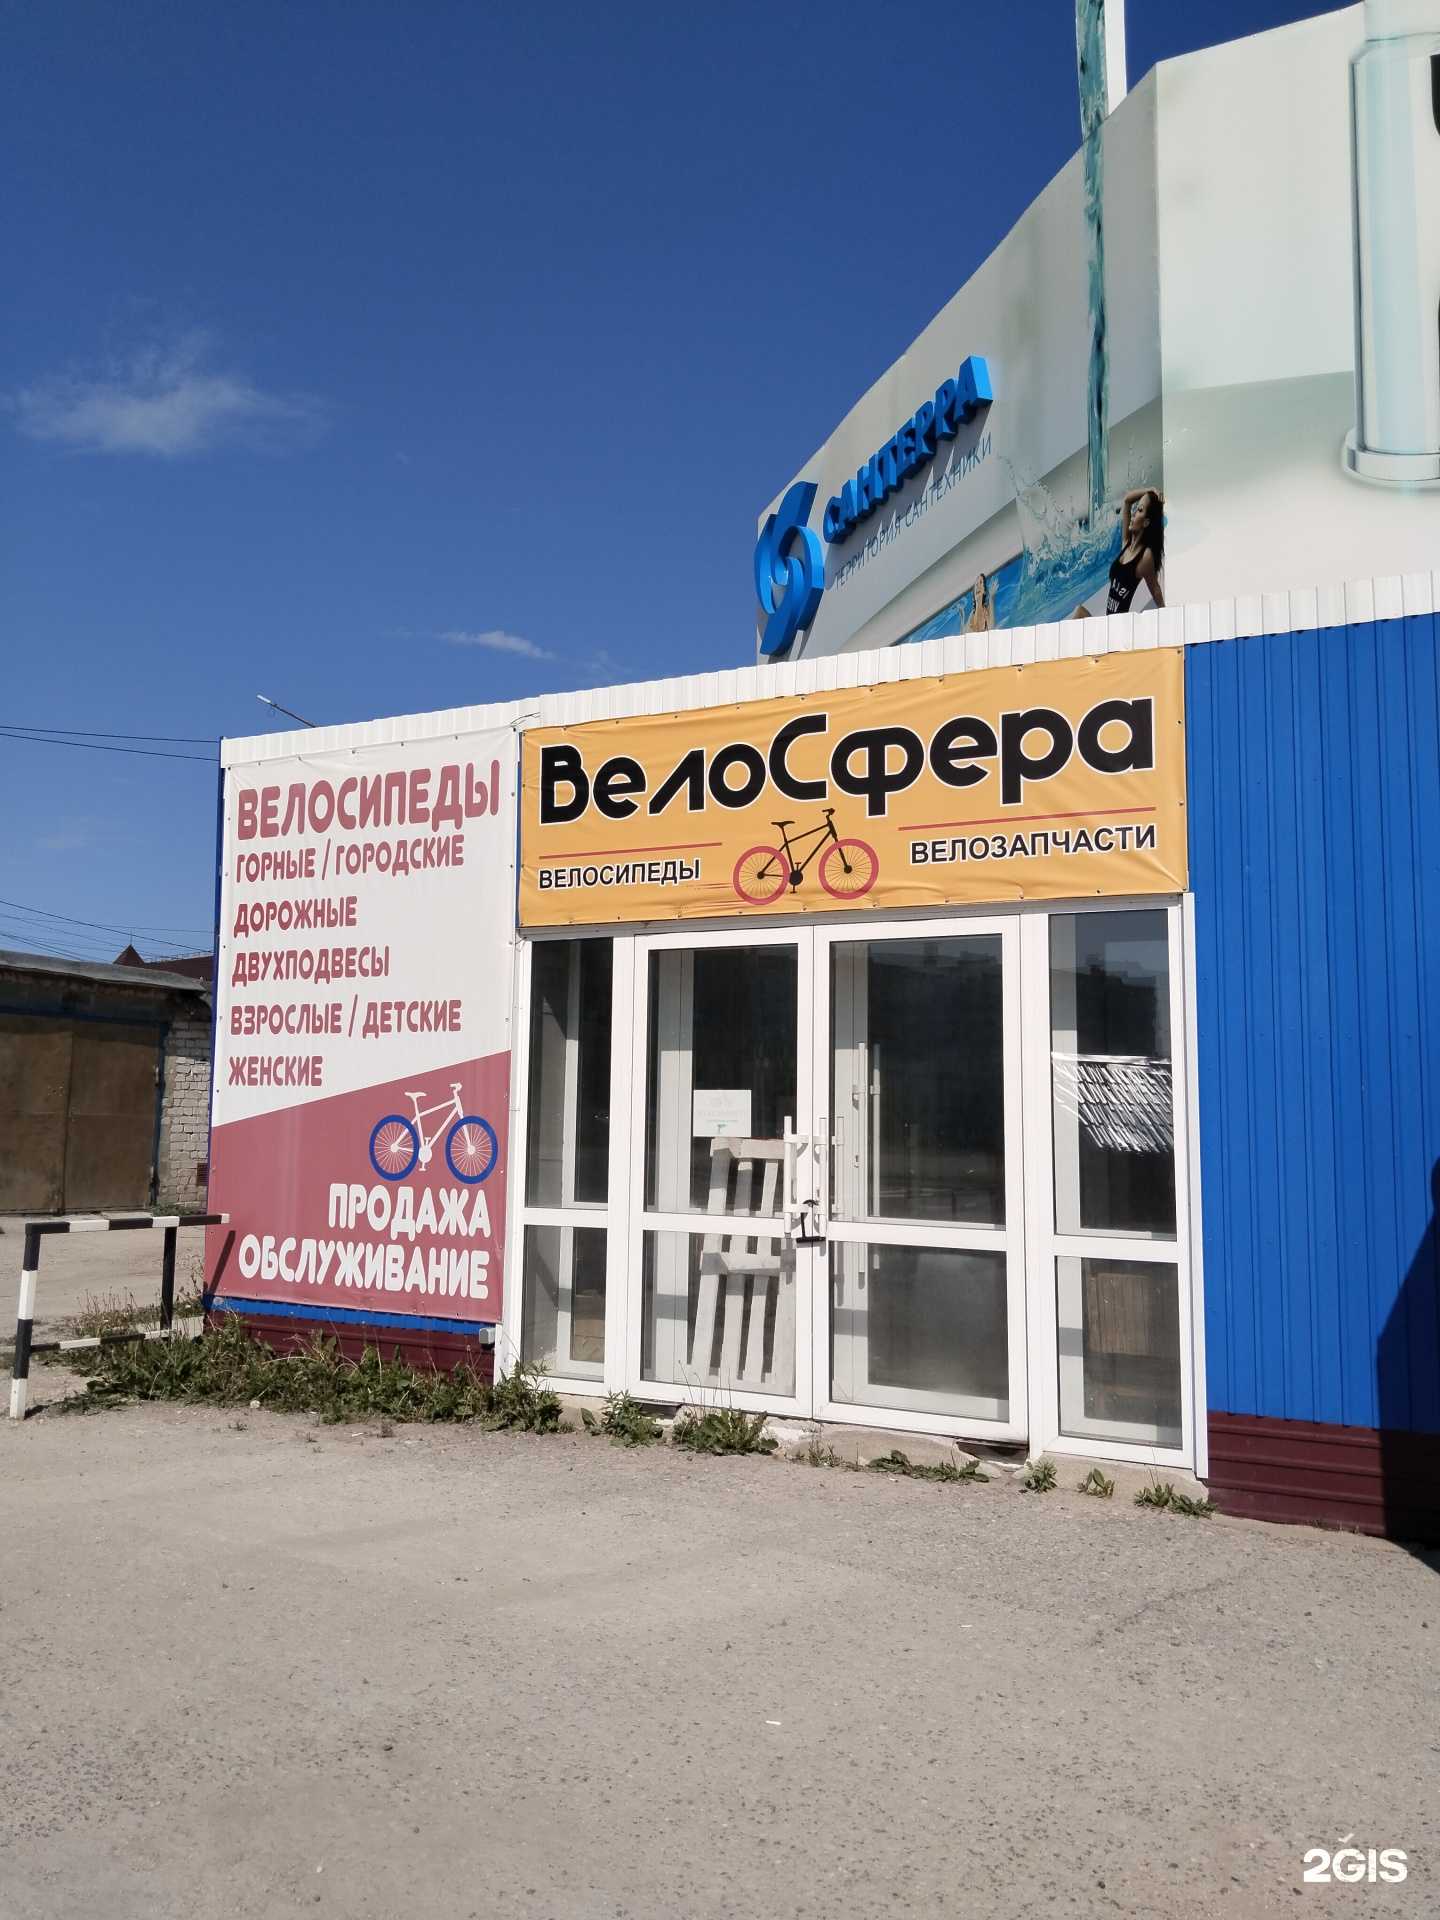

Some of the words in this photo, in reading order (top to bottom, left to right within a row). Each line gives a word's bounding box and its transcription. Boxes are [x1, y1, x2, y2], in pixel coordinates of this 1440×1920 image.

[823, 355, 992, 544] САНТЕРРА
[835, 516, 905, 591] ТЕРРИТОРИЯ
[905, 432, 992, 528] САНТЕХНИКИ
[540, 697, 1154, 824] ВелоСфера
[237, 759, 500, 840] ВЕЛОСИПЕДЫ
[236, 847, 316, 883] ГОРНЫЕ
[335, 834, 465, 877] ГОРОДСКИЕ
[910, 824, 1156, 865] ВЕЛОЗАПЧАСТИ
[539, 858, 701, 889] ВЕЛОСИПЕДЫ
[233, 896, 357, 938] ДОРОЖНЫЕ
[231, 945, 389, 987] ДВУХПОДВЕСЫ
[230, 1003, 342, 1035] ВЗРОСЛЫЕ
[362, 999, 461, 1039] ДЕТСКИЕ
[228, 1055, 322, 1086] ЖЕНСКИЕ
[328, 1183, 491, 1241] ПРОДАЖА
[238, 1233, 490, 1299] ОБСЛУЖИВАНИЕ
